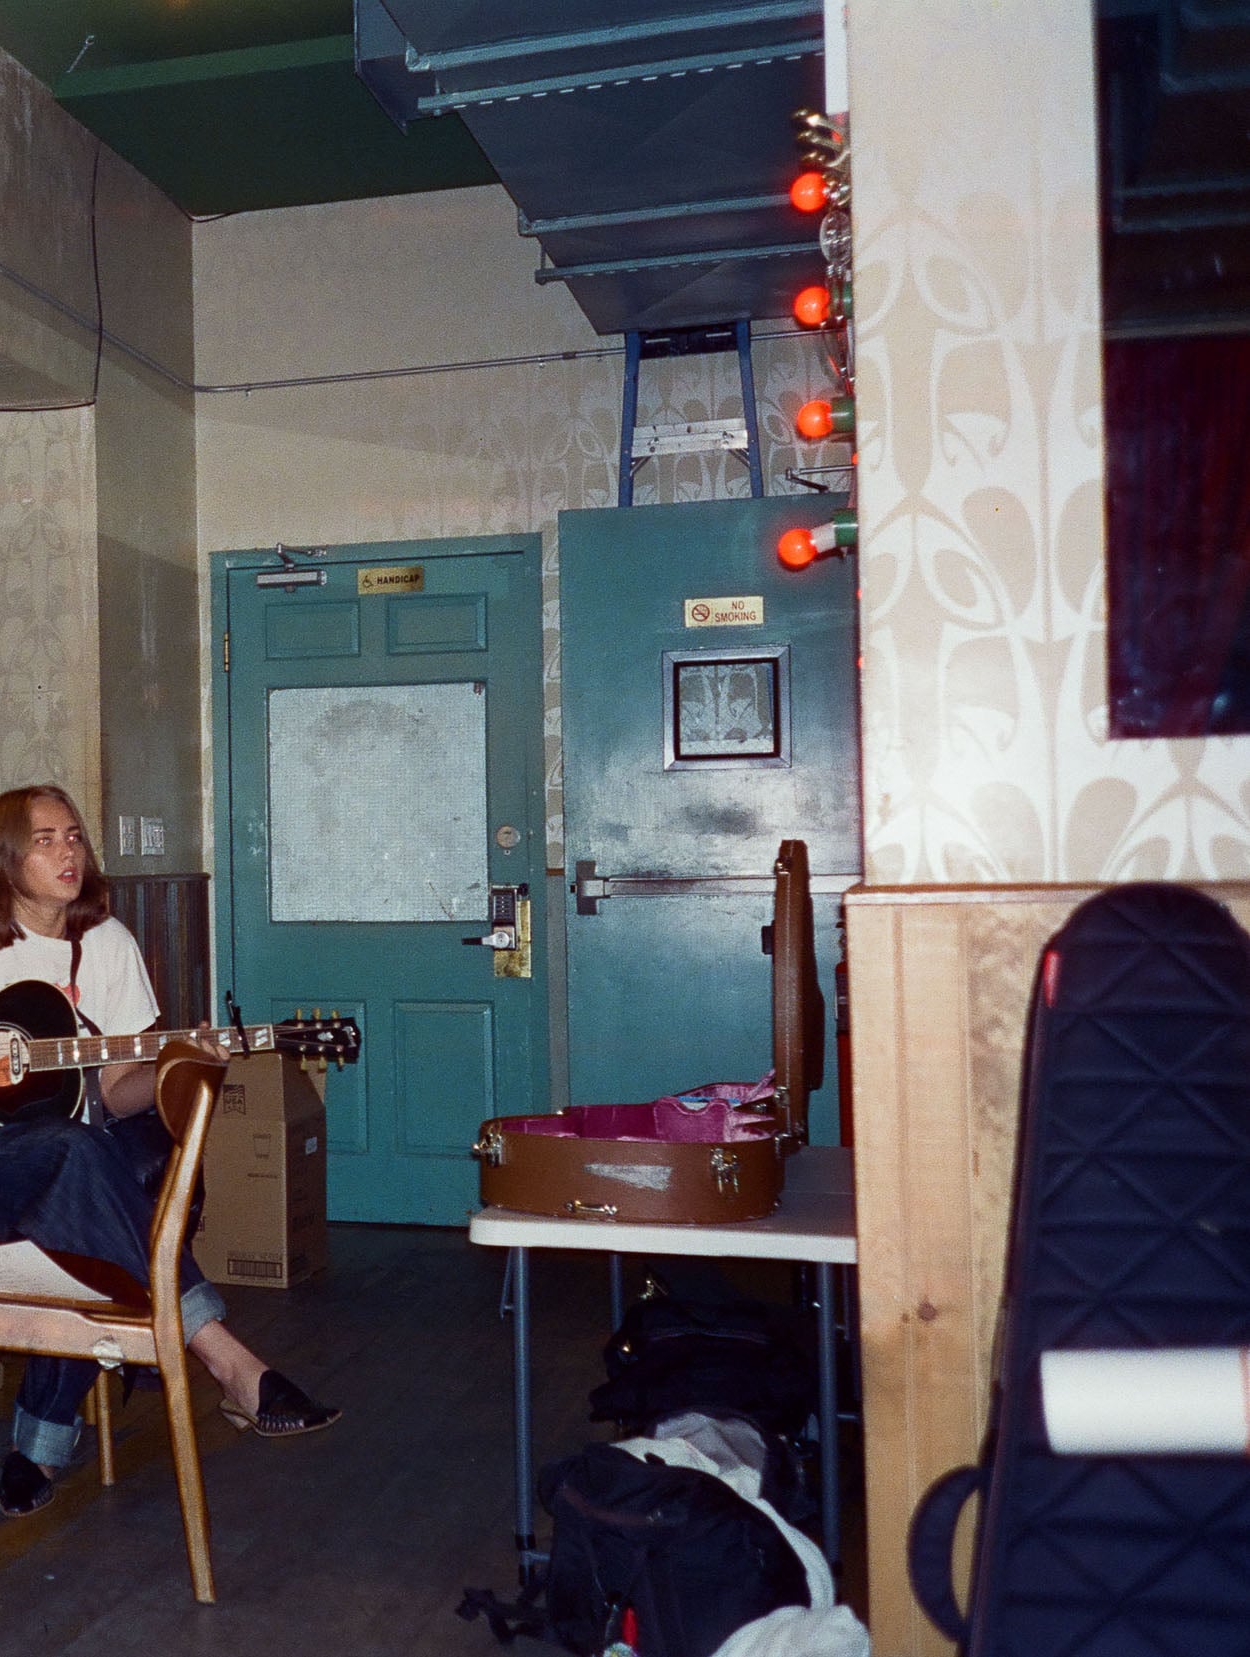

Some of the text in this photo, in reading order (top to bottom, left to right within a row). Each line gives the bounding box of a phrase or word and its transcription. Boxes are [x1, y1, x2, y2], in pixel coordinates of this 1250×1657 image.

[377, 574, 420, 585] HANDICAP
[731, 600, 745, 610] NO
[714, 611, 756, 622] SMOKING
